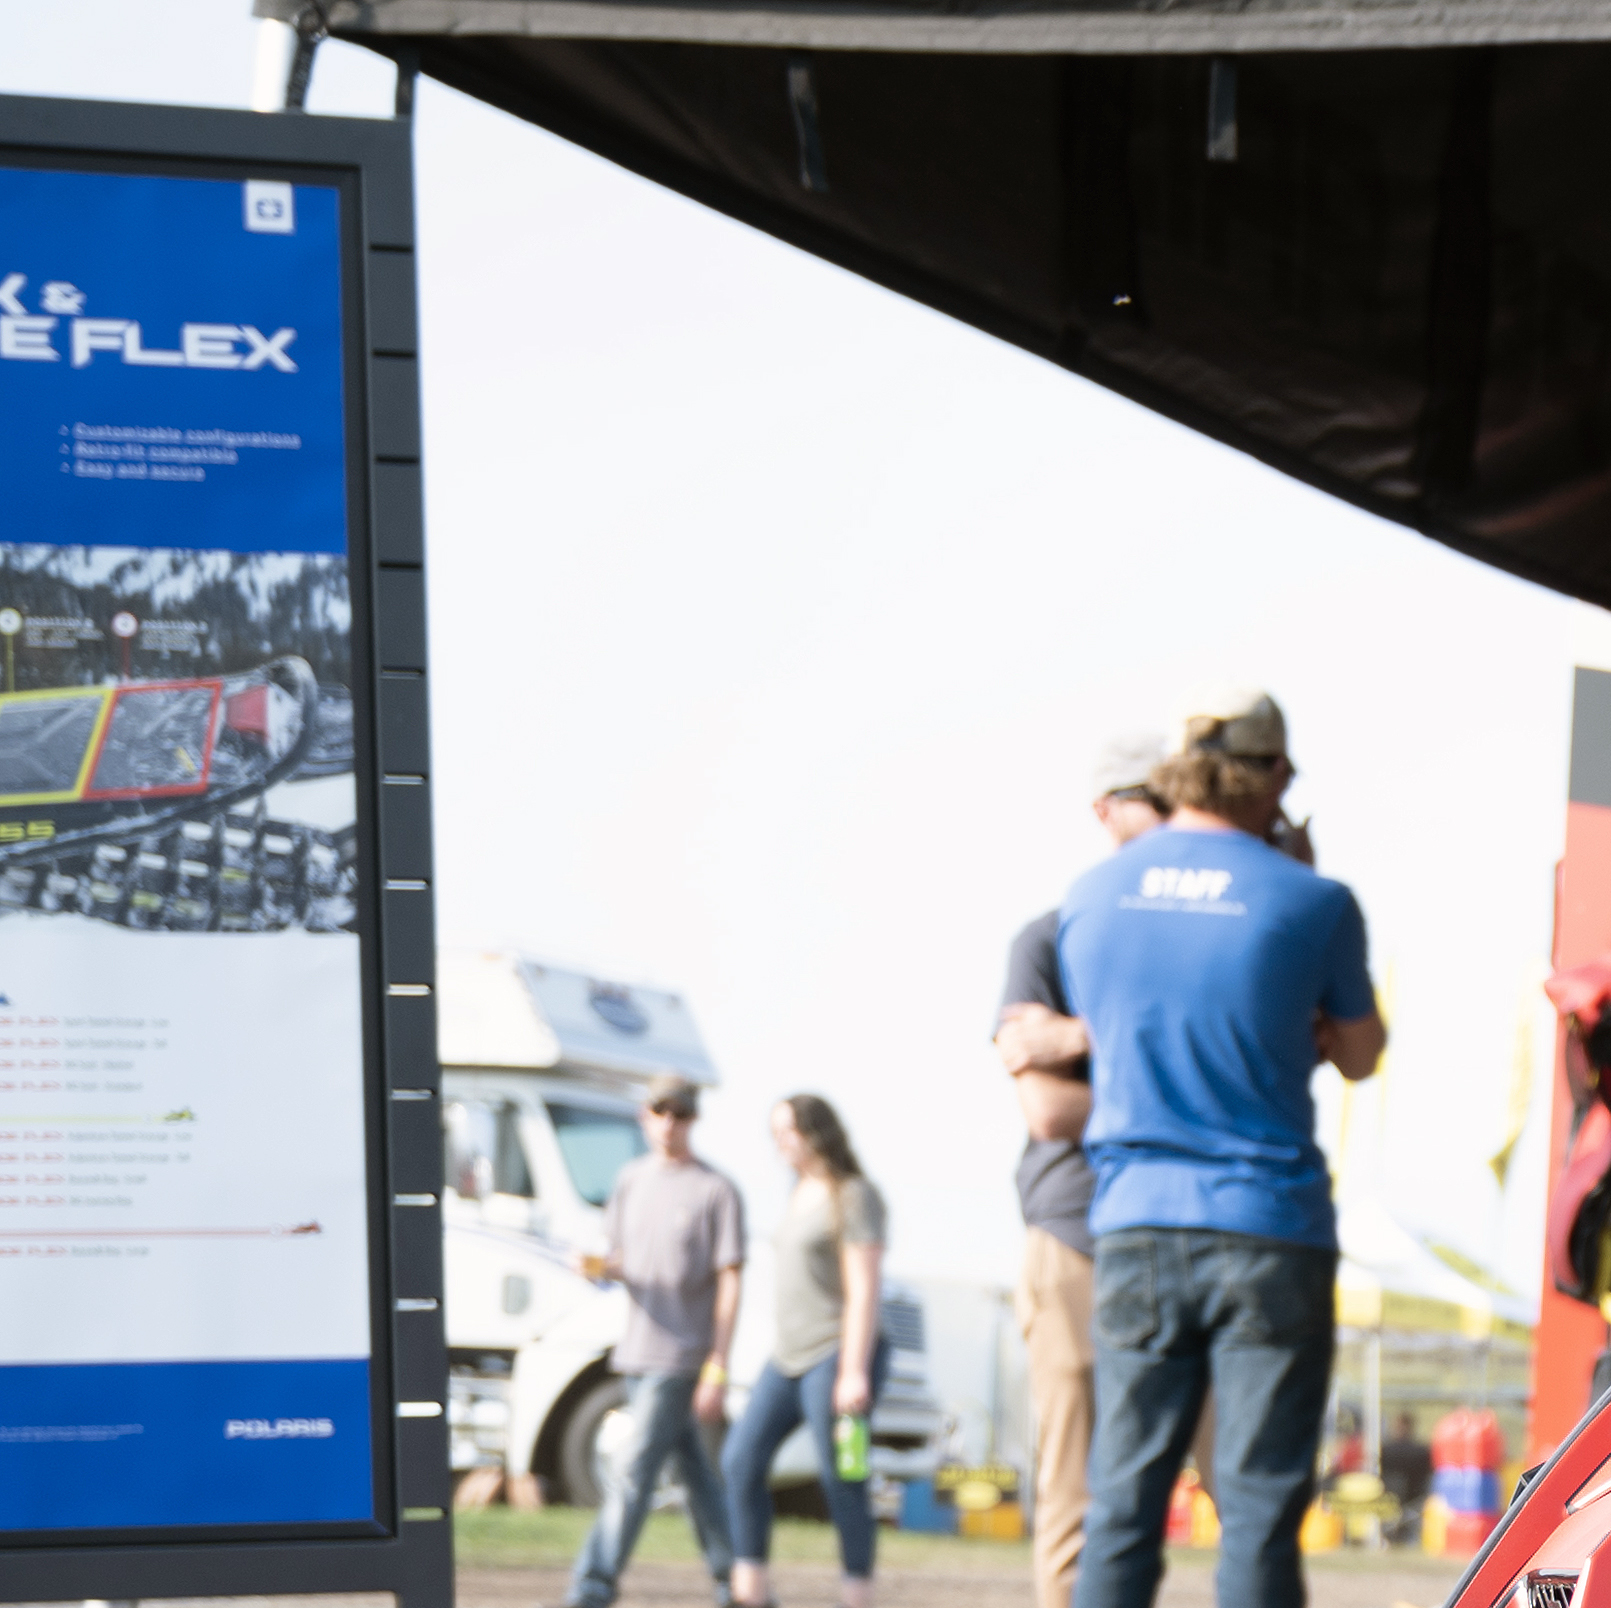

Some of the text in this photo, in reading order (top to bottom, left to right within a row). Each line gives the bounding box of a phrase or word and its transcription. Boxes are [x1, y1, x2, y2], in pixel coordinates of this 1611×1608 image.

[40, 281, 86, 315] &
[71, 317, 299, 374] FLEX
[1141, 866, 1233, 901] STAFF
[222, 1417, 336, 1441] POLARIS
